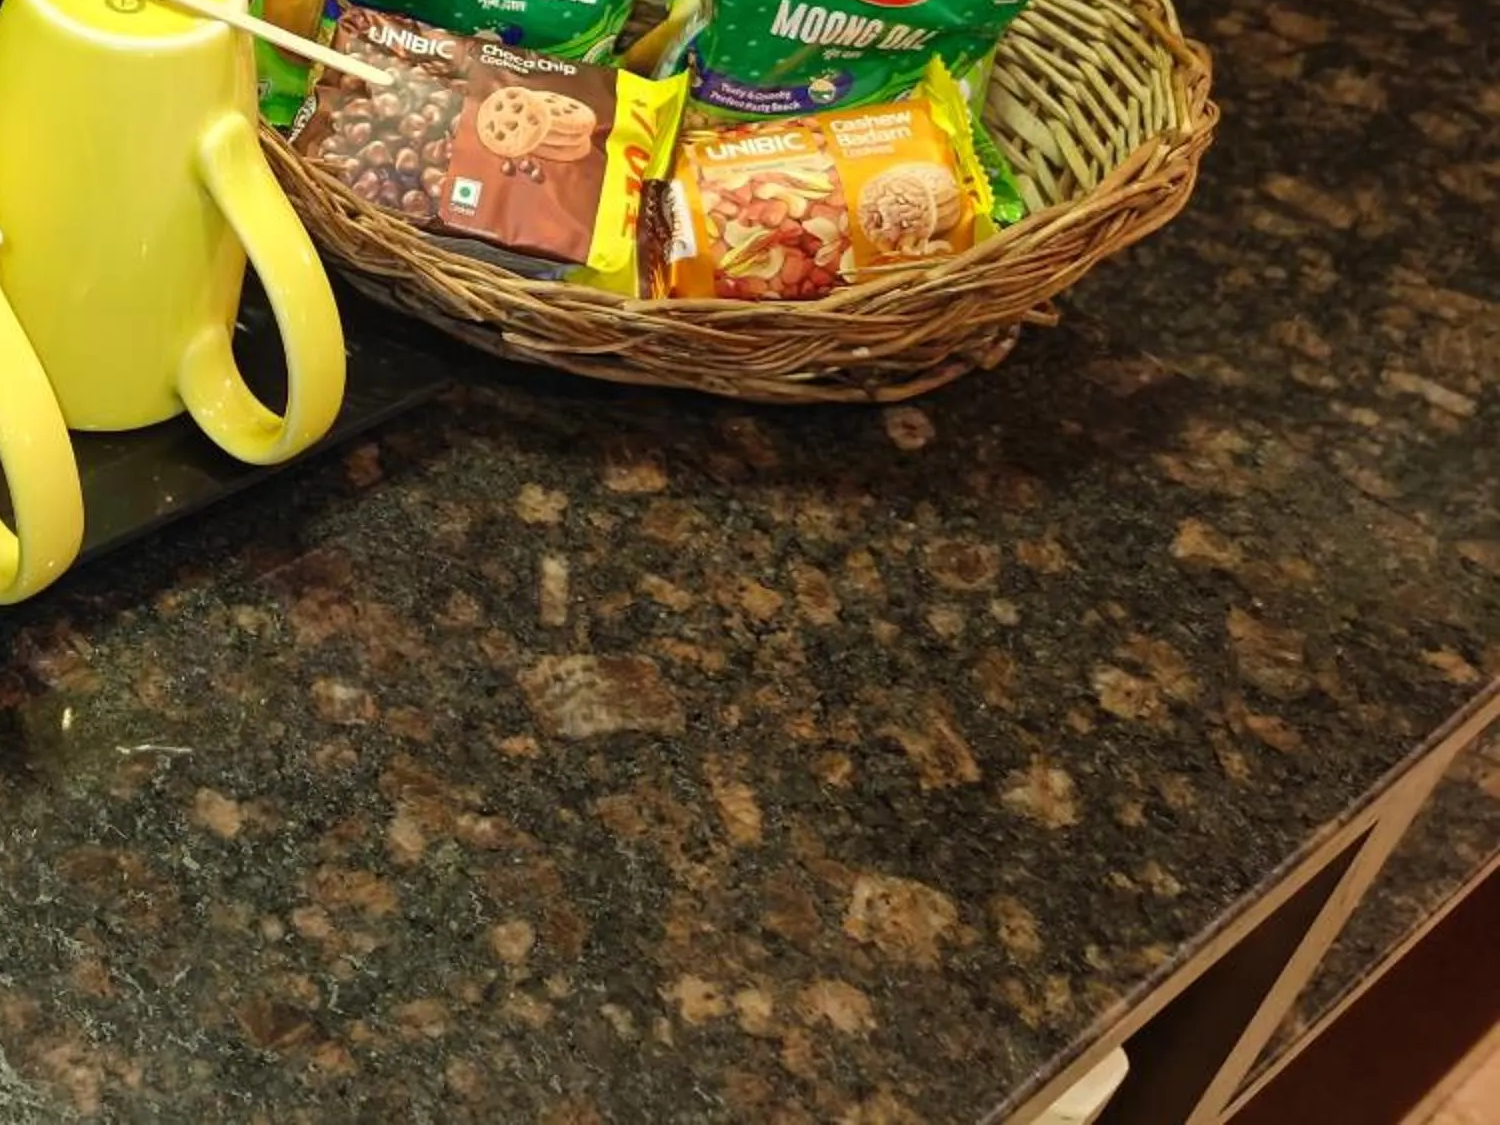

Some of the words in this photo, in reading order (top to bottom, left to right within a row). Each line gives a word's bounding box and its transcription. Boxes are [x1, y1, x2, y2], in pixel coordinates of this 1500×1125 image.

[368, 24, 456, 60] UNIBIC
[481, 44, 536, 68] Choco
[537, 58, 577, 75] Chip
[829, 111, 912, 132] Cashew
[705, 132, 806, 162] UNIBIC
